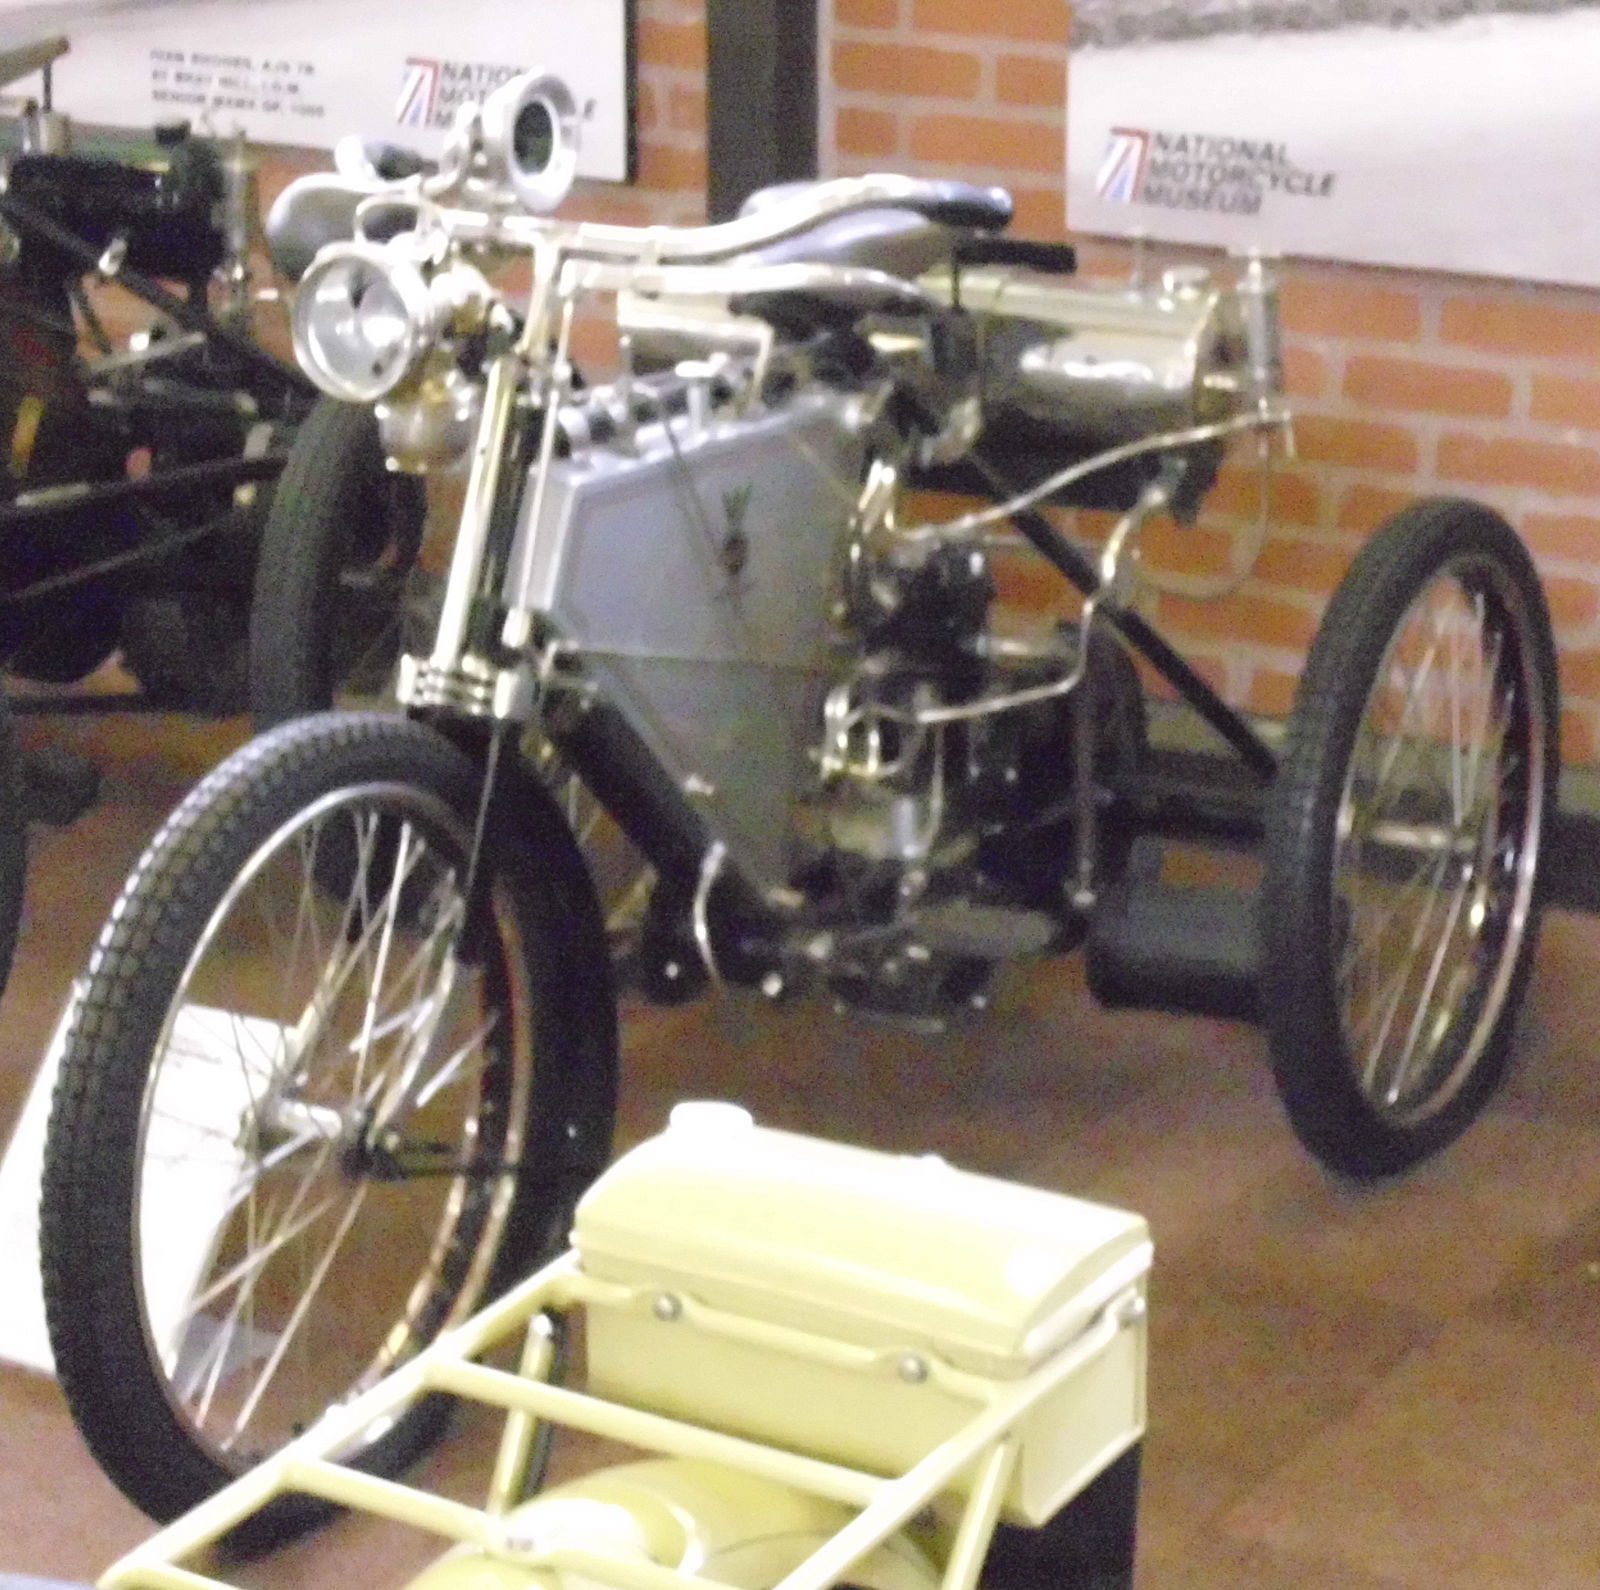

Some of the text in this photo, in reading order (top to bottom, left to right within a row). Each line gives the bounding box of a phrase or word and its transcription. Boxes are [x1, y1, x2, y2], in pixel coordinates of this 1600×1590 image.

[1156, 131, 1287, 166] NATIONAL
[1150, 158, 1336, 198] MOTORCYCLE
[1143, 184, 1262, 215] MUSEUM
